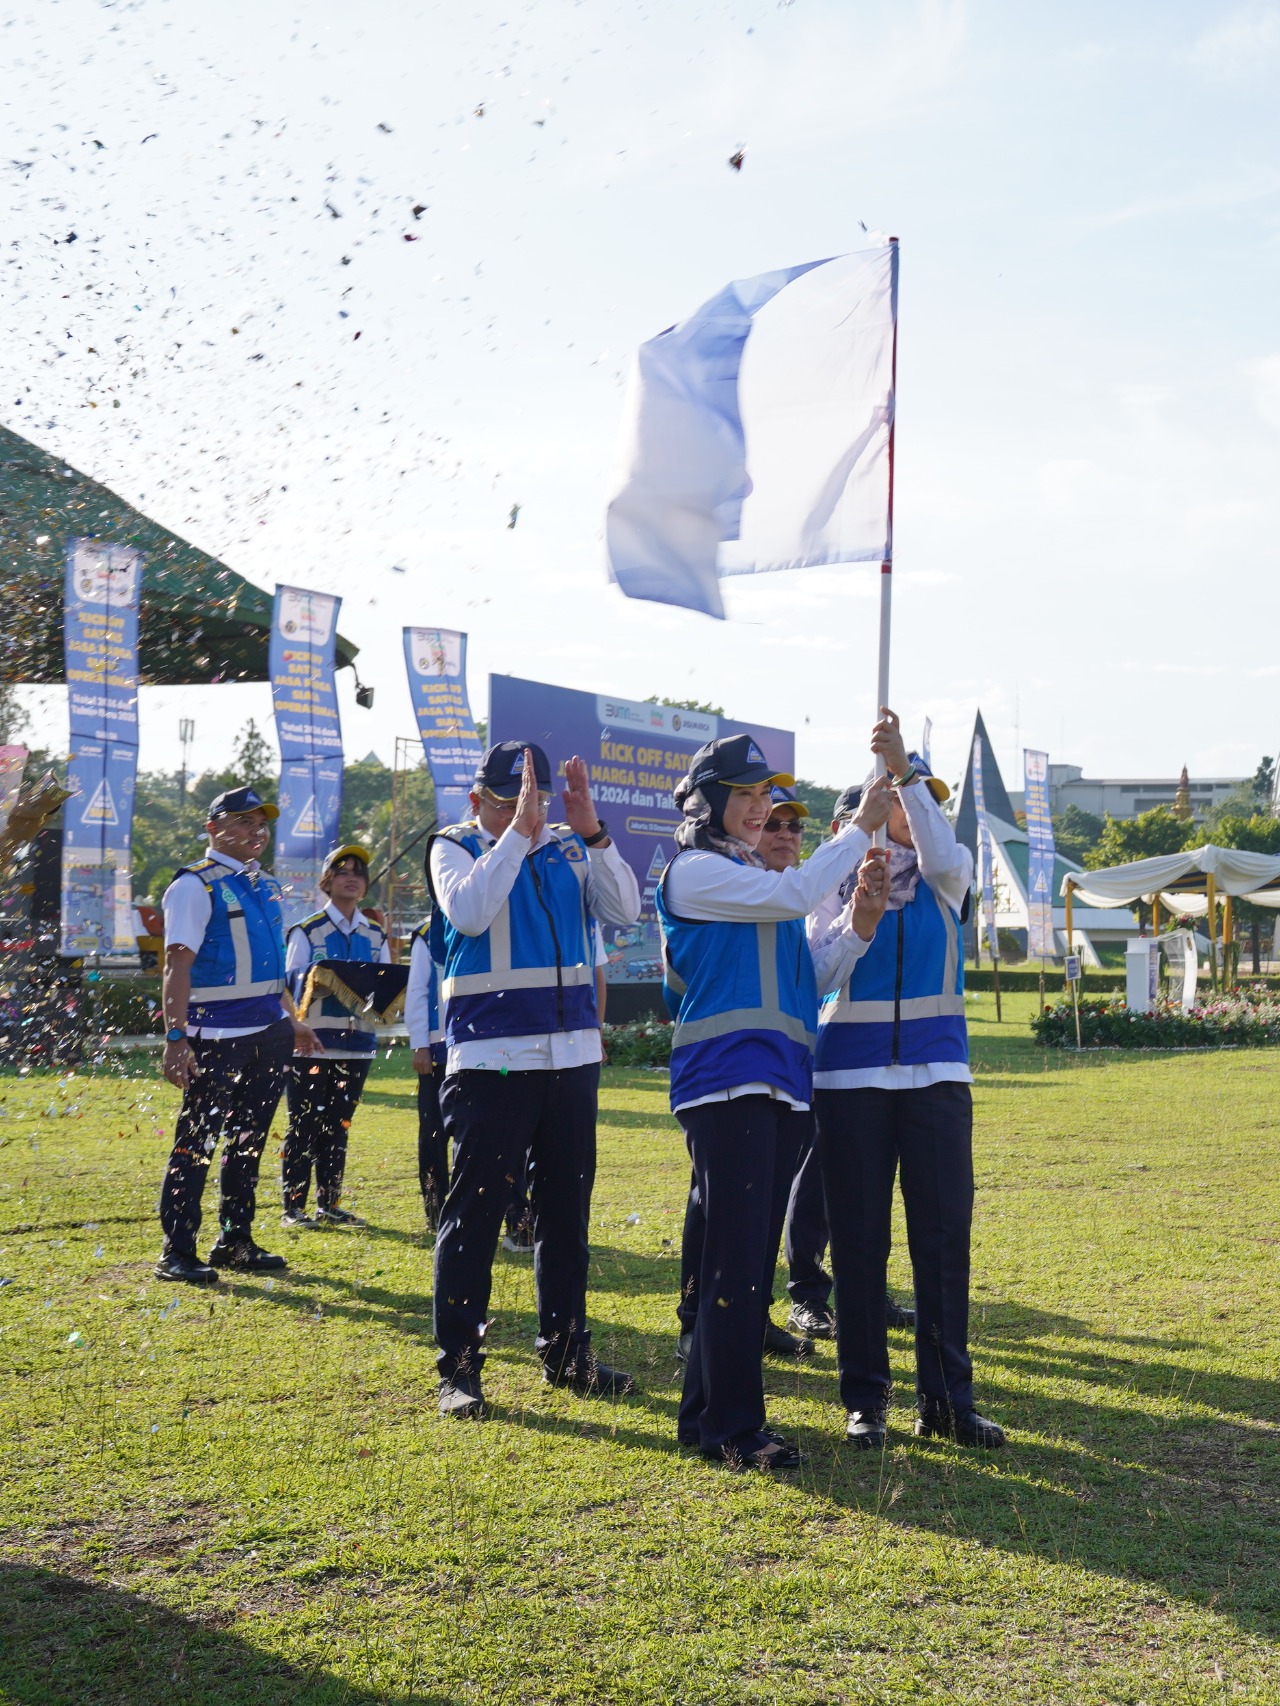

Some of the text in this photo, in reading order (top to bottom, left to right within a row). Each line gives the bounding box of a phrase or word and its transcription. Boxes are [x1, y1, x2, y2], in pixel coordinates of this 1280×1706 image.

[601, 741, 635, 764] KICK
[636, 746, 663, 768] OFF
[590, 764, 636, 787] MARGA
[637, 771, 673, 791] SIAGA
[600, 785, 630, 805] 2024
[631, 791, 655, 808] dan
[655, 792, 679, 811] Tah
